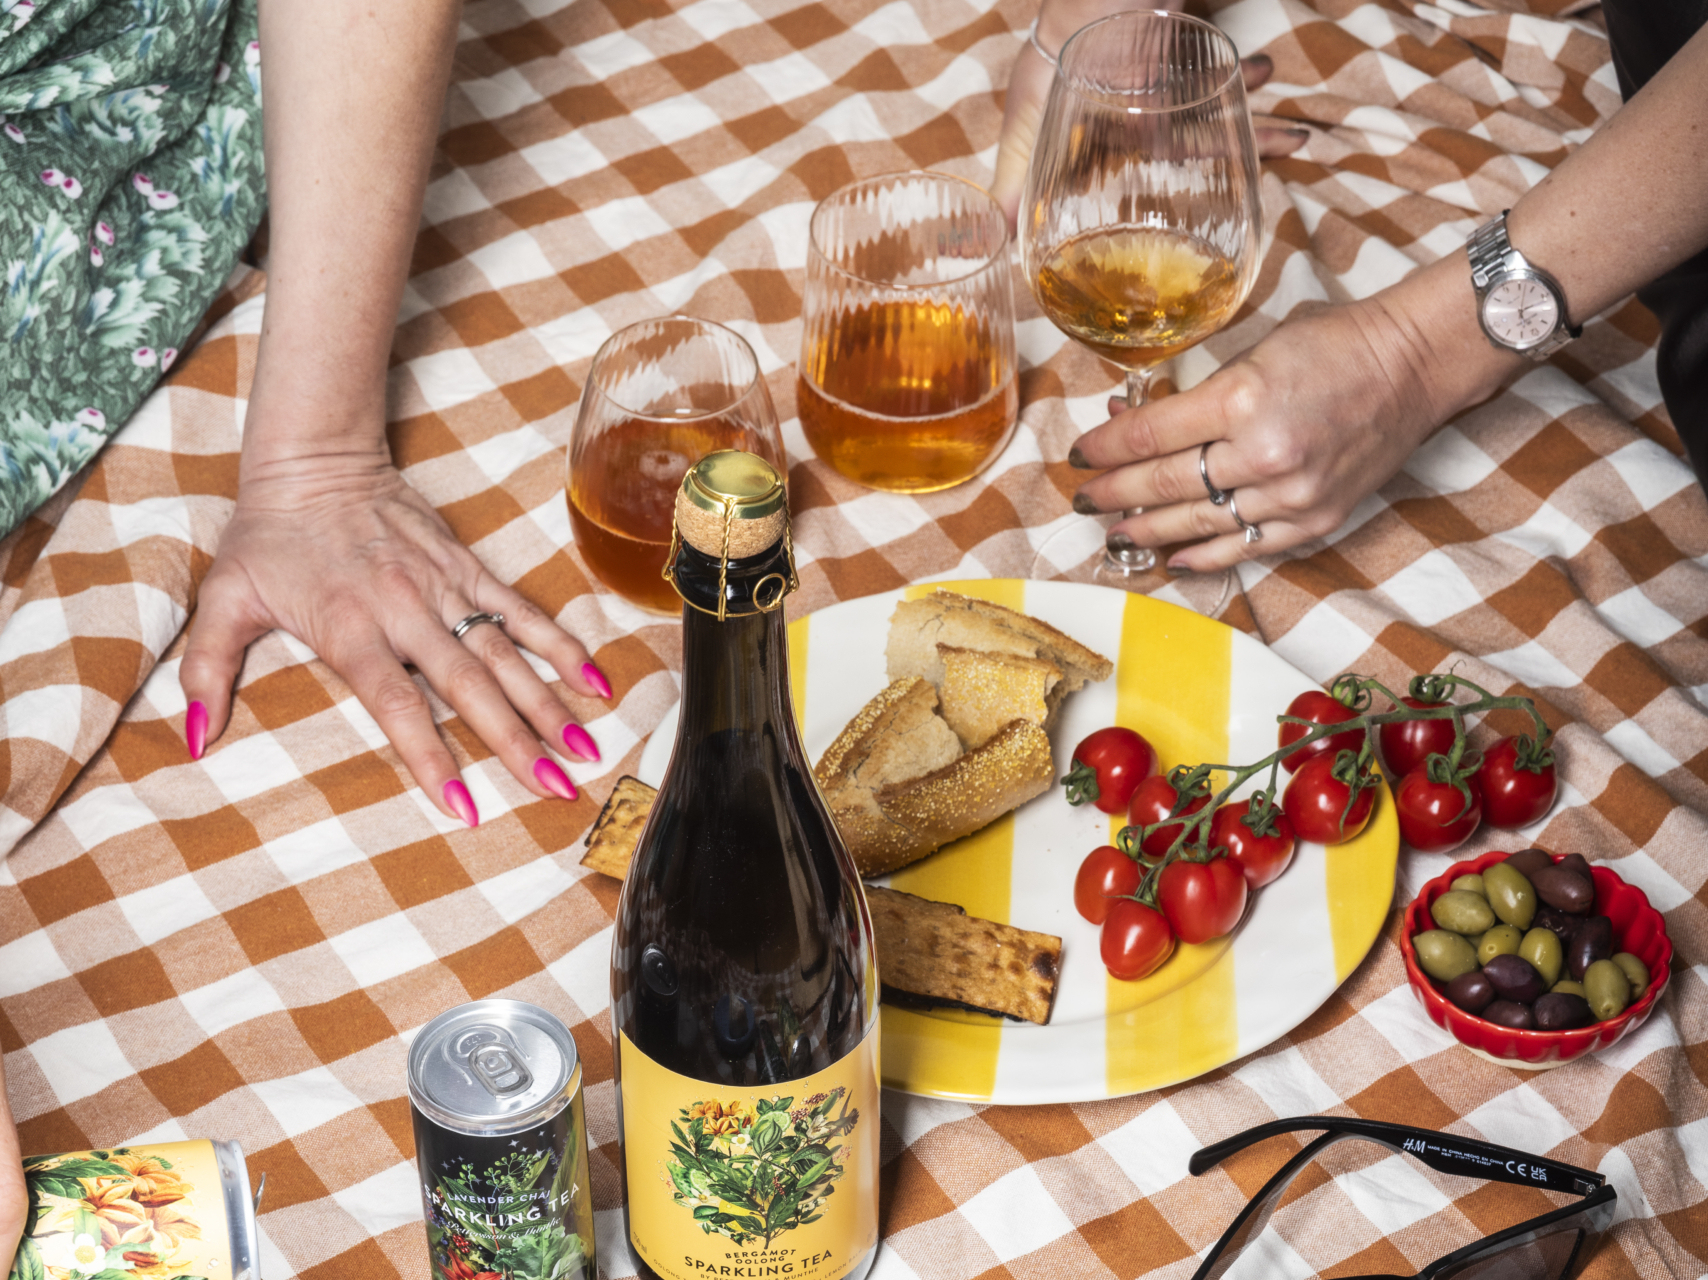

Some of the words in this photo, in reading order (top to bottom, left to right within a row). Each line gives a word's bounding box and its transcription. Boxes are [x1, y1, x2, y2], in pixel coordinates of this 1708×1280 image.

[1403, 1138, 1426, 1153] H&M
[1506, 1160, 1527, 1177] CE
[1531, 1166, 1546, 1175] UK
[1531, 1173, 1547, 1182] CA
[447, 1192, 514, 1204] LAVENDER
[520, 1190, 550, 1202] CHAI
[424, 1184, 541, 1227] SPARKLING
[549, 1182, 580, 1212] TEA
[725, 1249, 797, 1259] BERGAMOT
[735, 1256, 785, 1264] OOLONG
[654, 1259, 680, 1280] OOLONG
[824, 1262, 846, 1279] LEMON
[684, 1255, 794, 1278] SPARKLING
[801, 1249, 833, 1269] TEA
